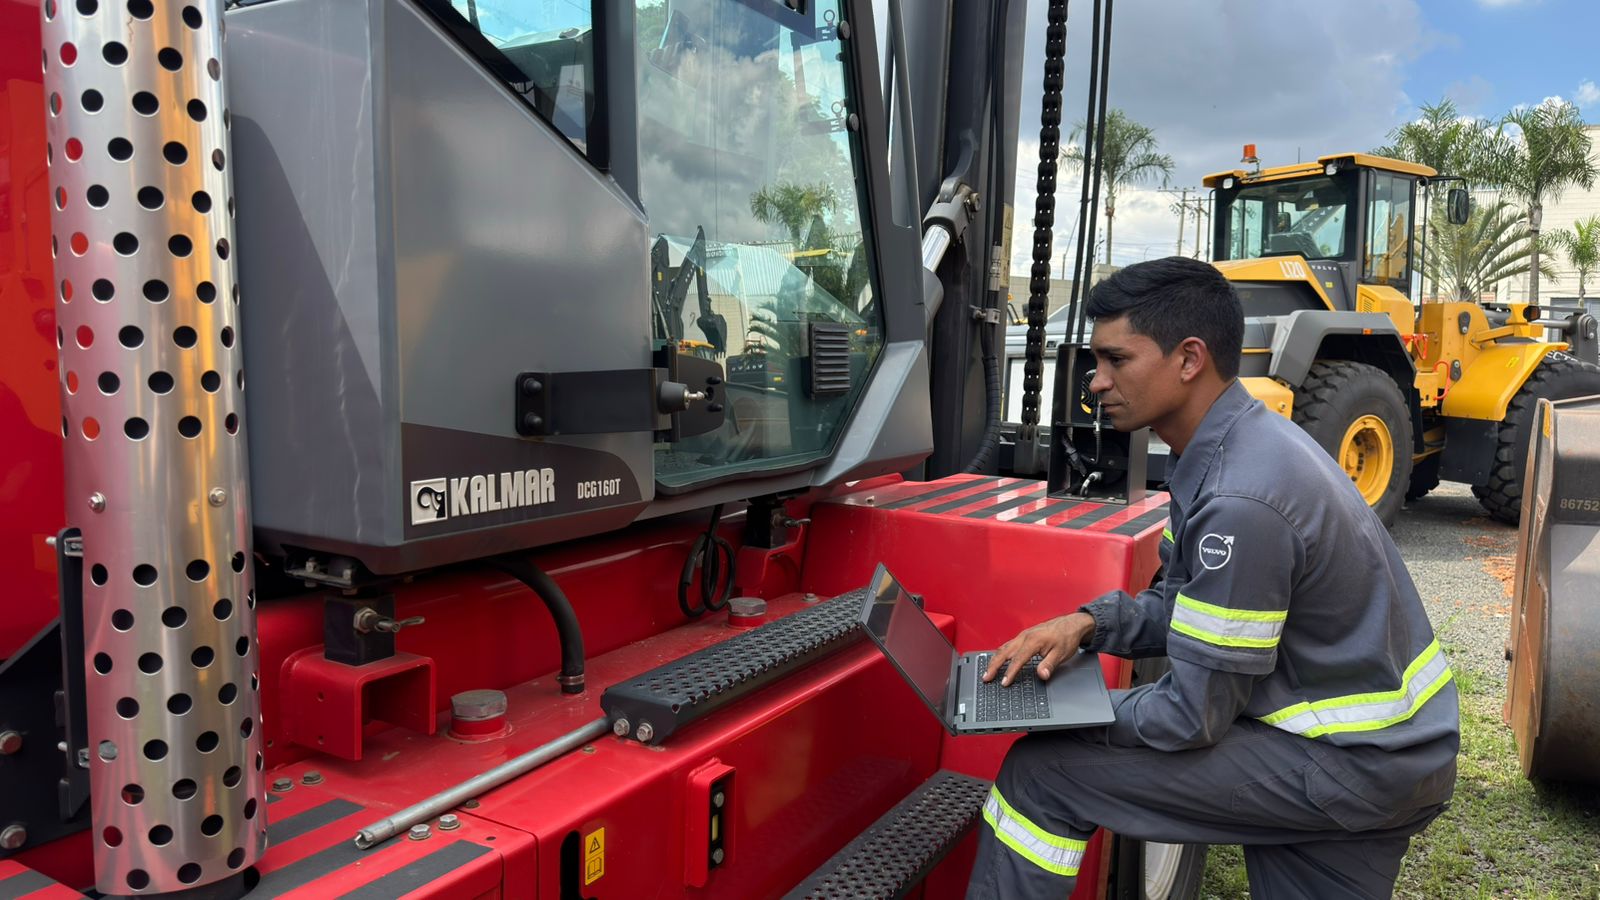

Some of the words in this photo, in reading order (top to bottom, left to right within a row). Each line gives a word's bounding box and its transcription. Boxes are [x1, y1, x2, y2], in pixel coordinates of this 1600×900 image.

[1279, 260, 1306, 278] L120
[450, 467, 556, 517] KALMAR
[577, 478, 621, 500] DCG160T
[1560, 498, 1600, 511] 86752
[1202, 547, 1227, 556] VOLVO
